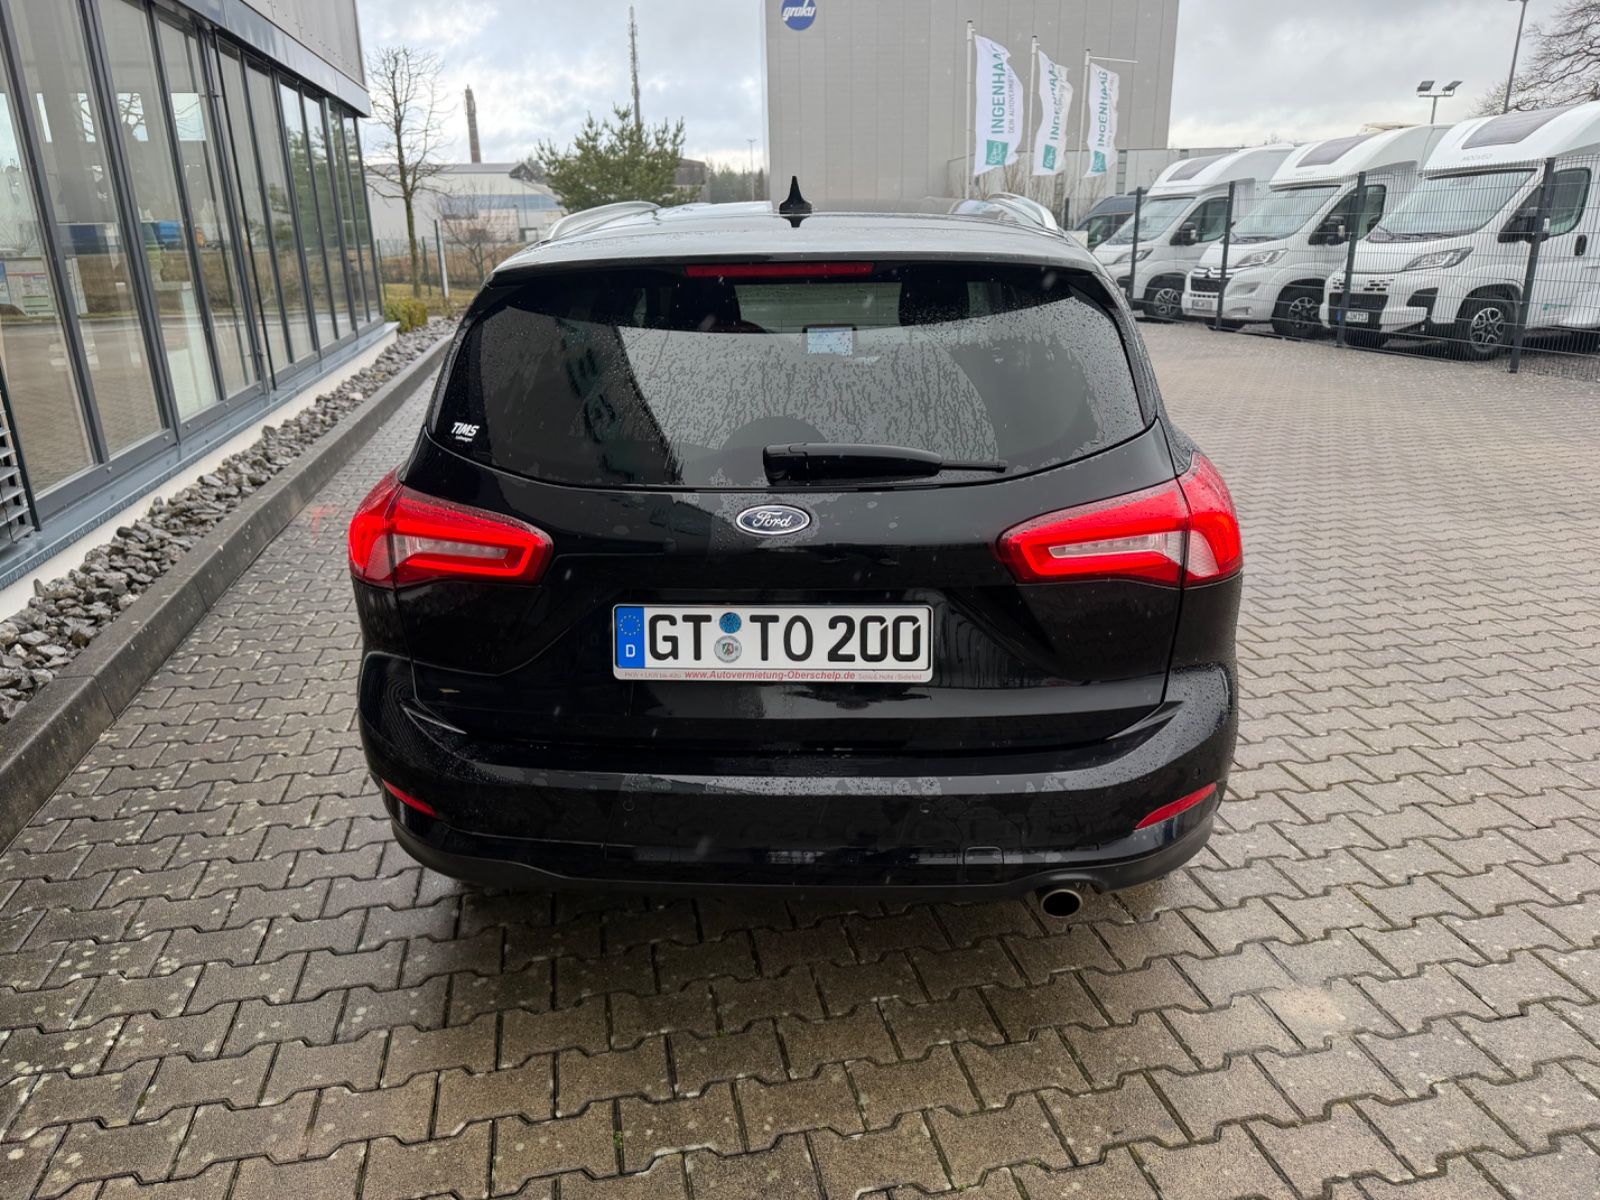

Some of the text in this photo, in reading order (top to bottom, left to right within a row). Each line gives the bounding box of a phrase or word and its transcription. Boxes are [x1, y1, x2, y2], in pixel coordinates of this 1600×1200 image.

[451, 421, 480, 437] TIMS
[752, 511, 793, 527] Ford
[649, 614, 921, 663] GT TO 200
[625, 644, 636, 658] D
[684, 670, 856, 681] www.Autovermietung-Oberschelp.de
